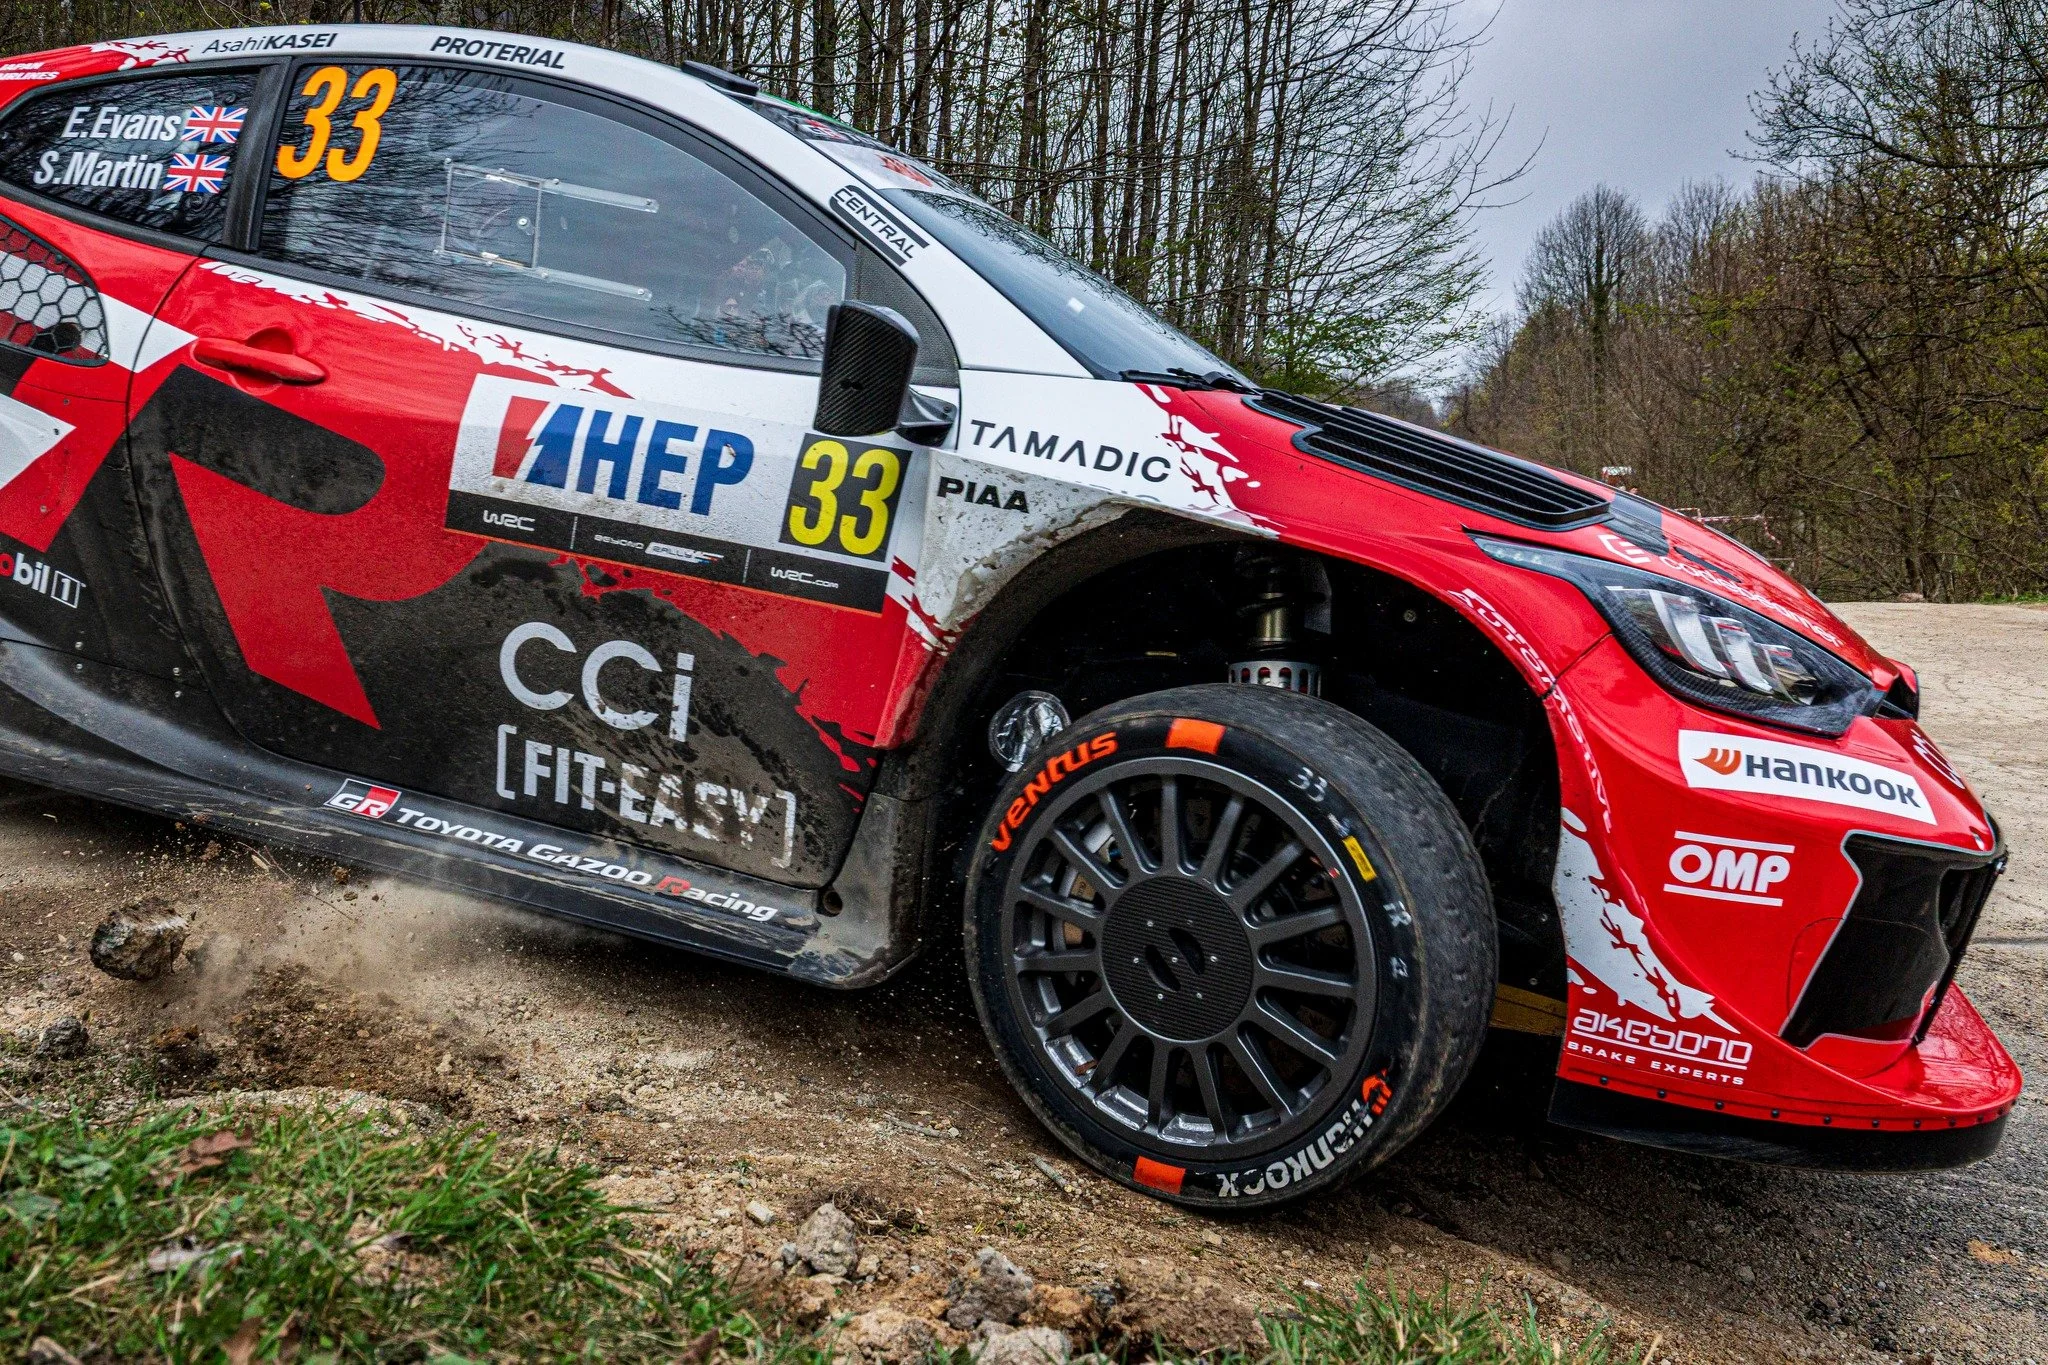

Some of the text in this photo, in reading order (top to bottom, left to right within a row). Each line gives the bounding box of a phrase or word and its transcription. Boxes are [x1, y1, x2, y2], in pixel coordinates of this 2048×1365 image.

[202, 32, 337, 53] AsahiKASEI
[430, 35, 565, 70] PROTERIAL
[61, 106, 182, 141] E.Evans
[276, 66, 398, 182] 33
[33, 150, 163, 190] S.Martin
[833, 187, 916, 259] CENTRAL
[576, 409, 754, 516] HEP
[971, 419, 1171, 483] TAMADIC
[789, 440, 900, 555] 33
[937, 476, 1029, 514] PIAA
[483, 510, 536, 532] WRC
[329, 793, 778, 922] GR TOYOTA GAZOO Racing
[1669, 844, 1791, 894] OMP
[1572, 1008, 1753, 1064] akebono
[1567, 1041, 1744, 1086] BRAKE EXPERTS
